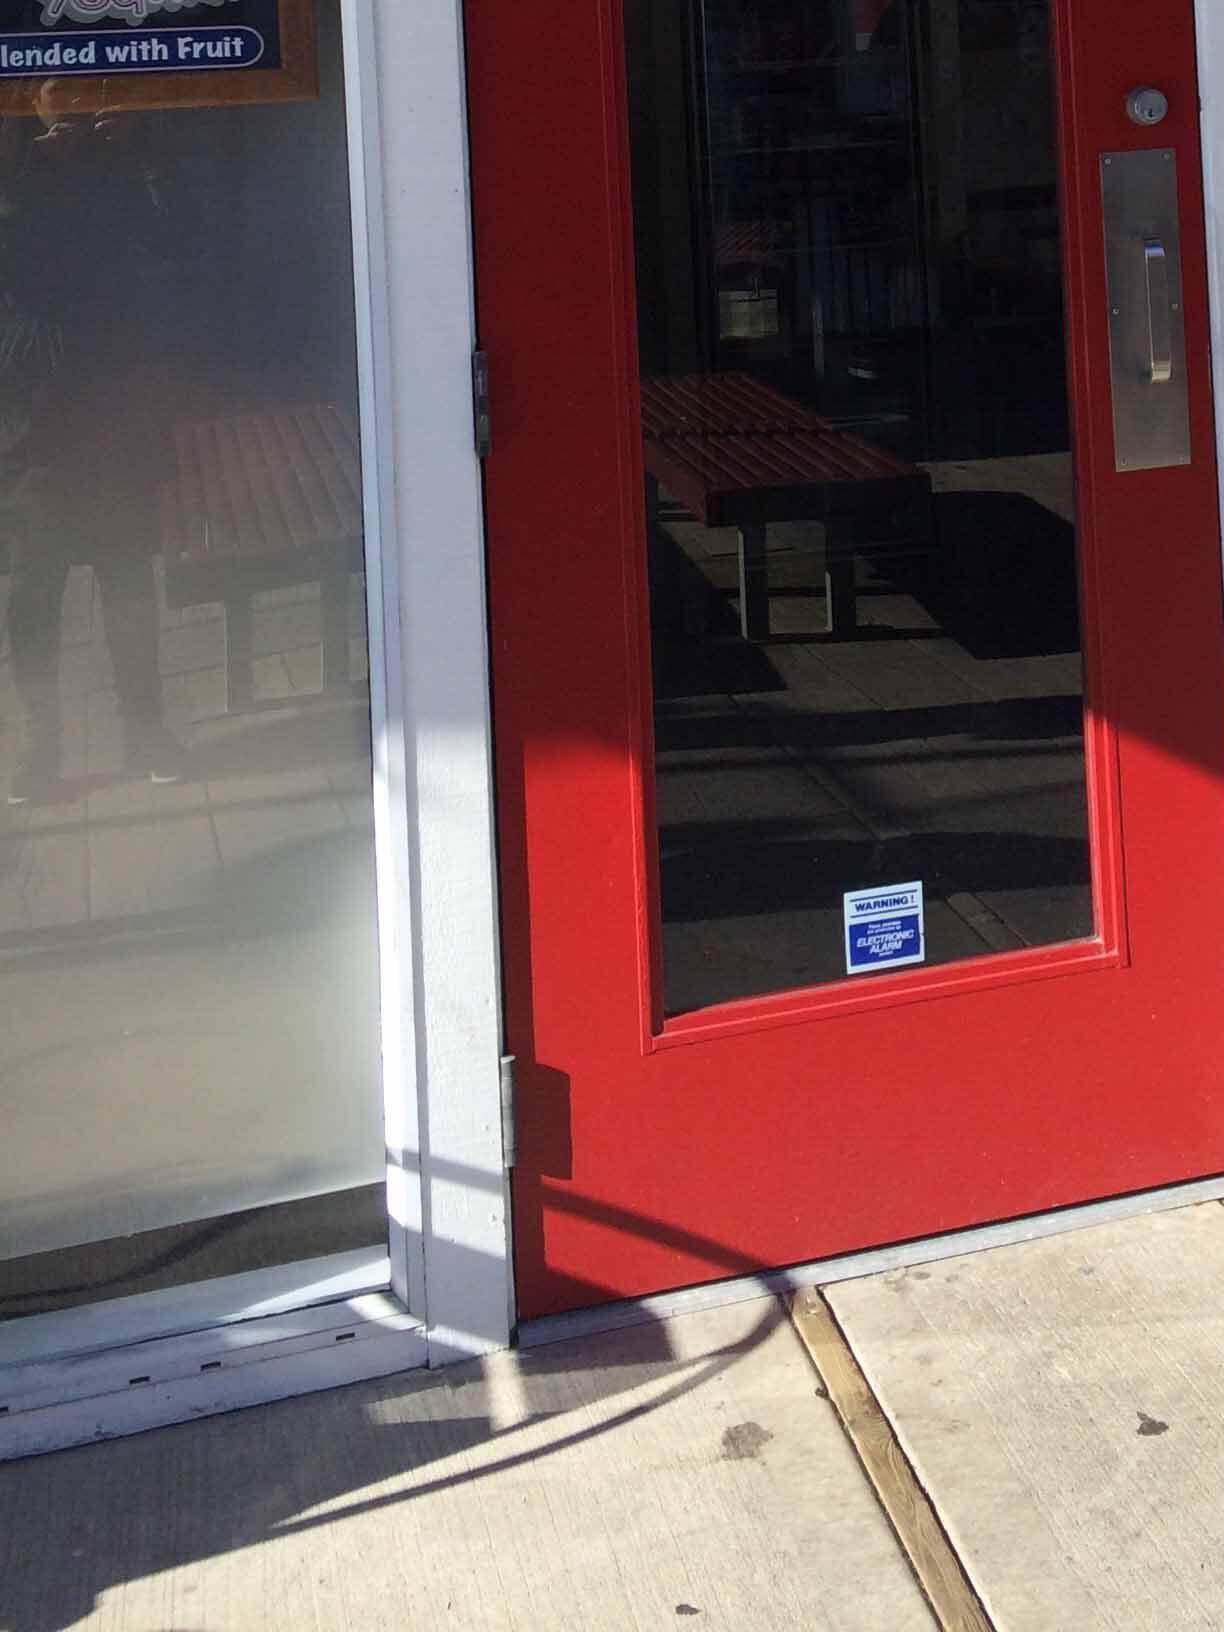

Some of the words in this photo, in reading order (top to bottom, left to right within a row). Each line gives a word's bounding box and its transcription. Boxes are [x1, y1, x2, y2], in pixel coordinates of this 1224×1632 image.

[105, 41, 169, 63] with
[177, 36, 245, 61] Fruit
[856, 929, 915, 948] ELECTRONIC
[869, 939, 903, 955] ALARM
